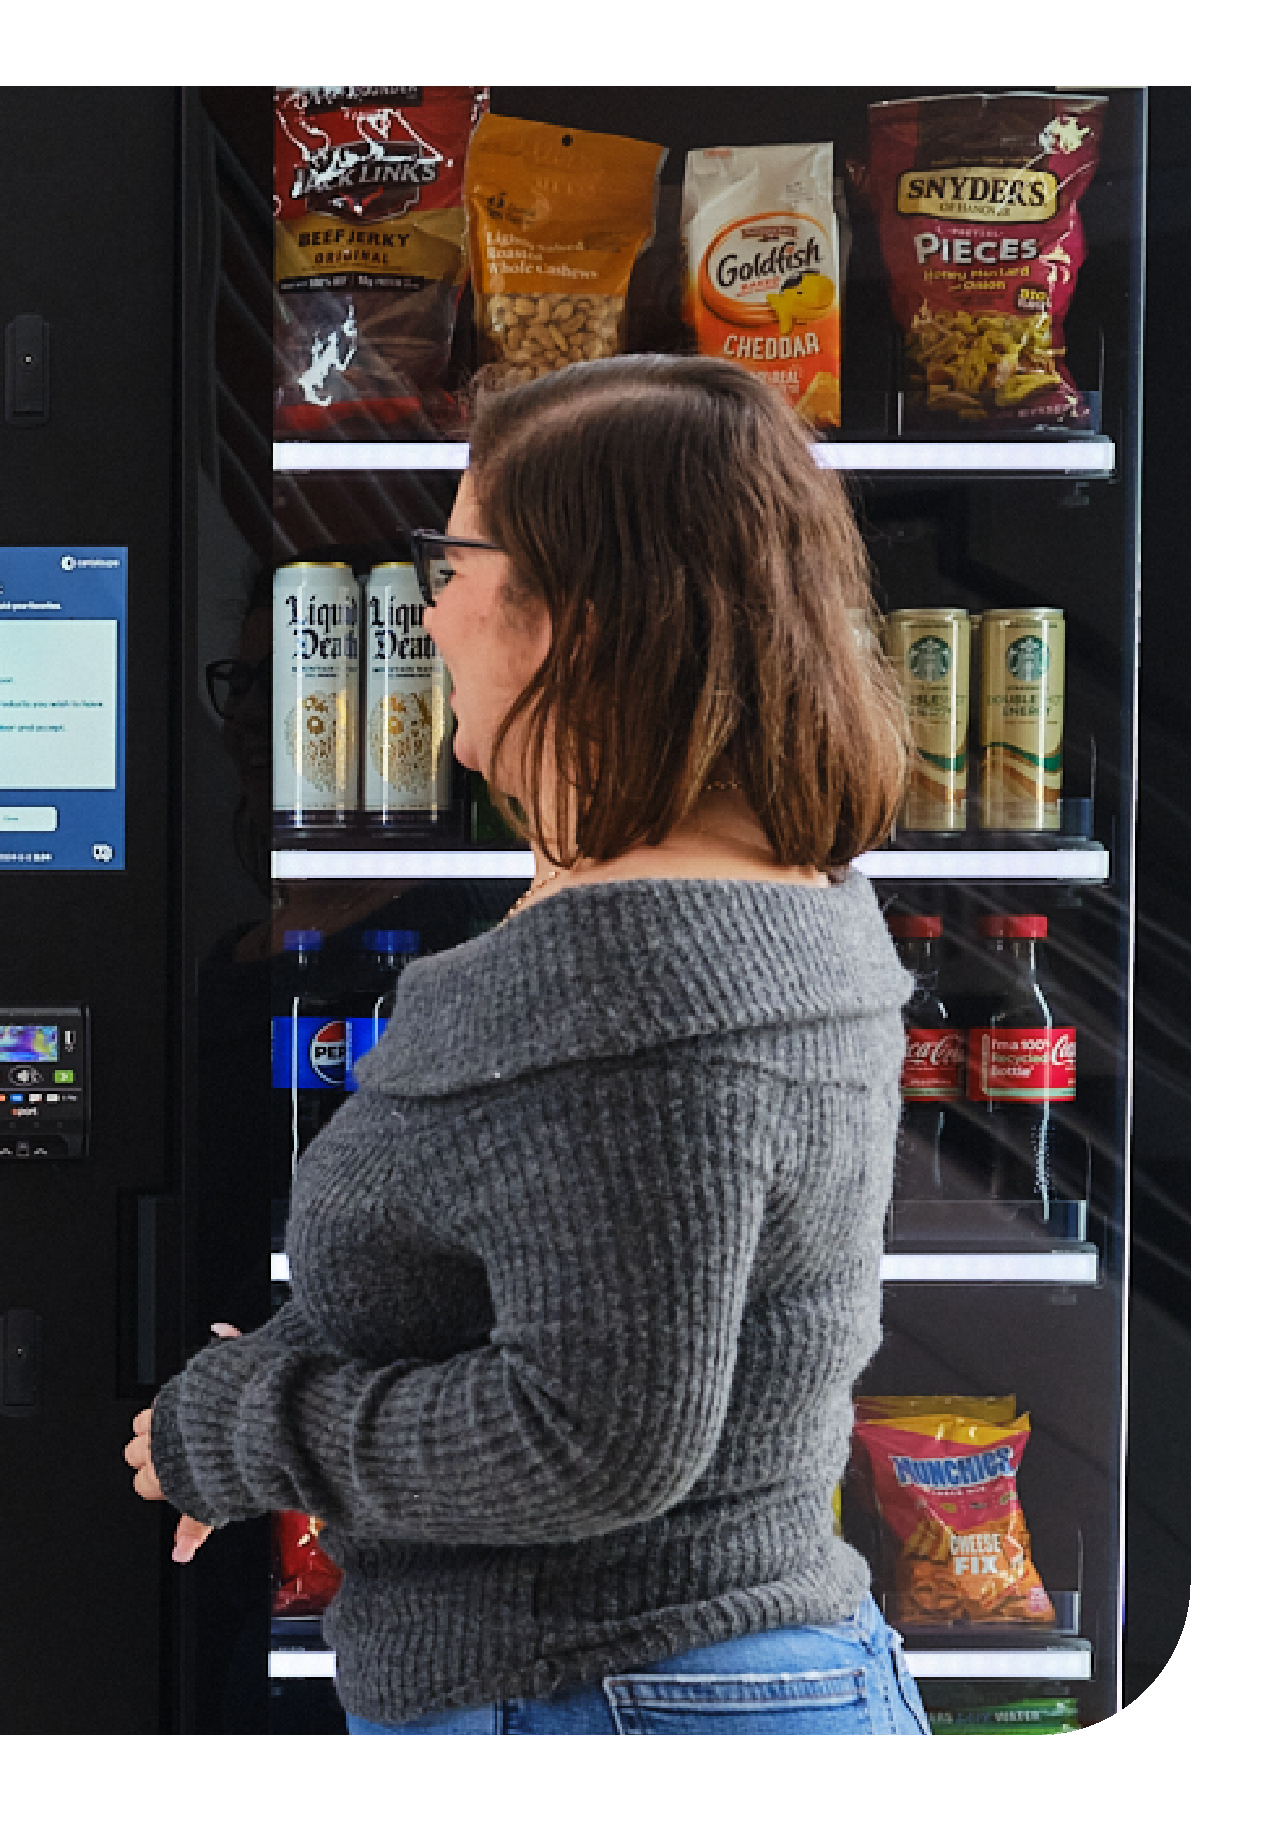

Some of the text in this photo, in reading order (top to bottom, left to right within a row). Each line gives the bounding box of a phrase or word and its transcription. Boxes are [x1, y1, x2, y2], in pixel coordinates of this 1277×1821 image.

[298, 230, 411, 248] BEEF JERKY
[914, 233, 1038, 265] PIECES
[716, 236, 822, 288] Goldfish
[723, 332, 822, 361] CHEDDAR
[369, 595, 425, 635] Liqu
[889, 1445, 1016, 1490] MUNCHIES
[950, 1534, 1002, 1555] CHEESE
[955, 1556, 999, 1576] FIX
